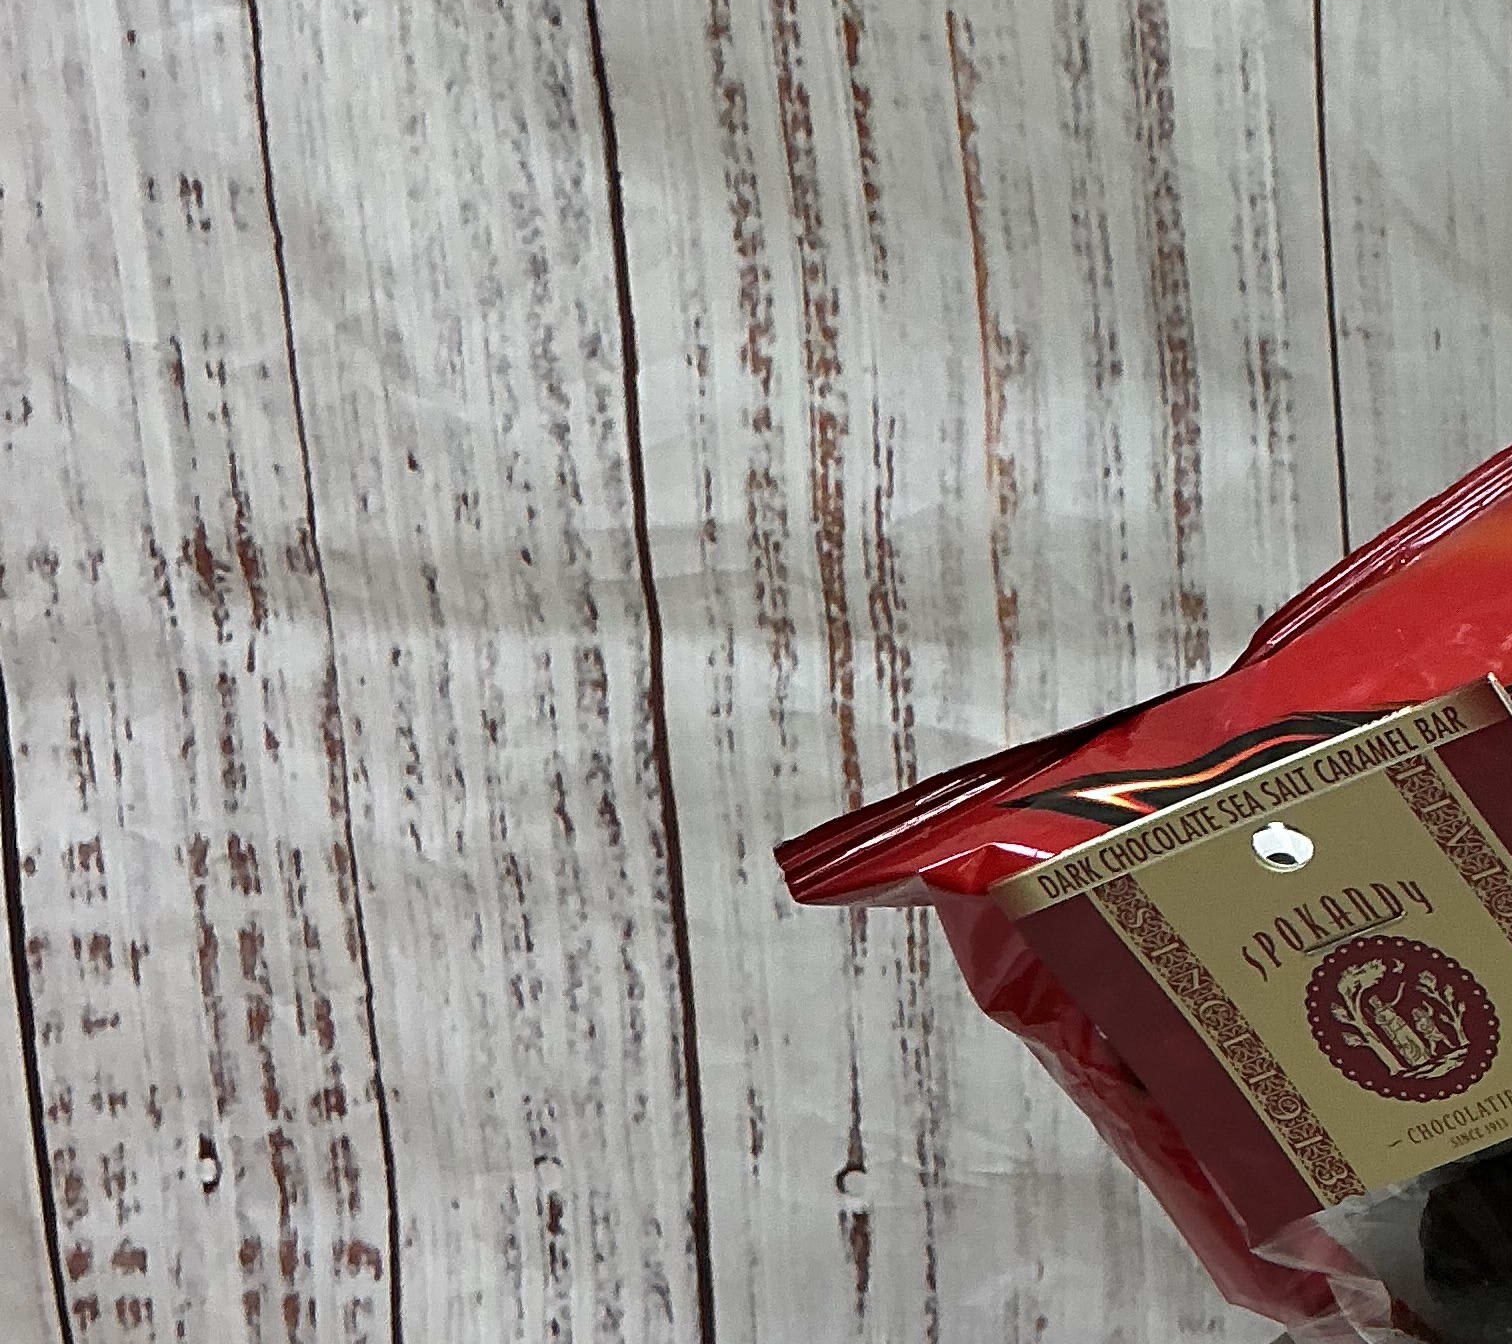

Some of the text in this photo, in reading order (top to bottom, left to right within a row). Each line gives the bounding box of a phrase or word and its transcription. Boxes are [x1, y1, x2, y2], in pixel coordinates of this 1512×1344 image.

[1037, 706, 1468, 899] DARK CHOCOLATE SEA SALT CARAMEL BAR
[1242, 880, 1433, 982] SPOKANDY
